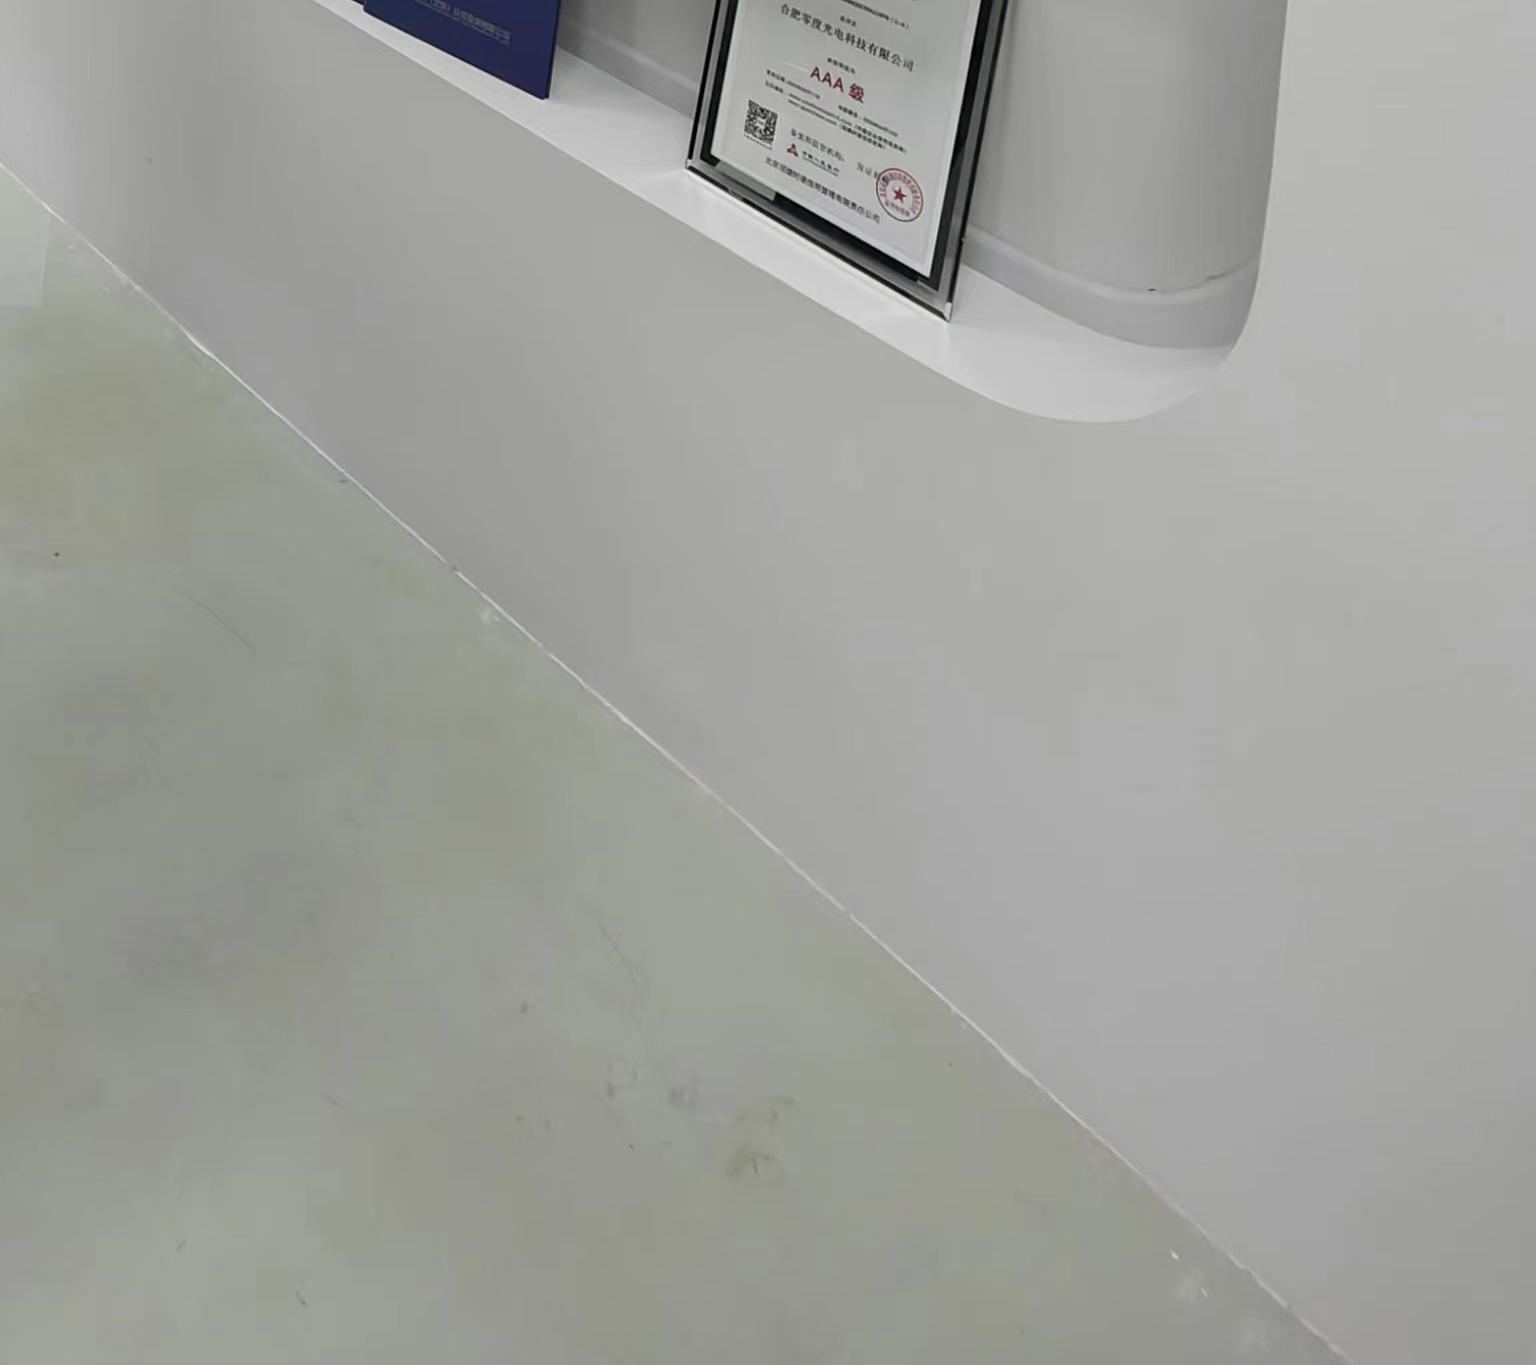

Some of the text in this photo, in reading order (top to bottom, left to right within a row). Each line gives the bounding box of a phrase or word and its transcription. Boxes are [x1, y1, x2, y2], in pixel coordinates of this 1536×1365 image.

[781, 3, 914, 73] 合肥零度光电科技有限公司
[810, 66, 845, 93] AAA
